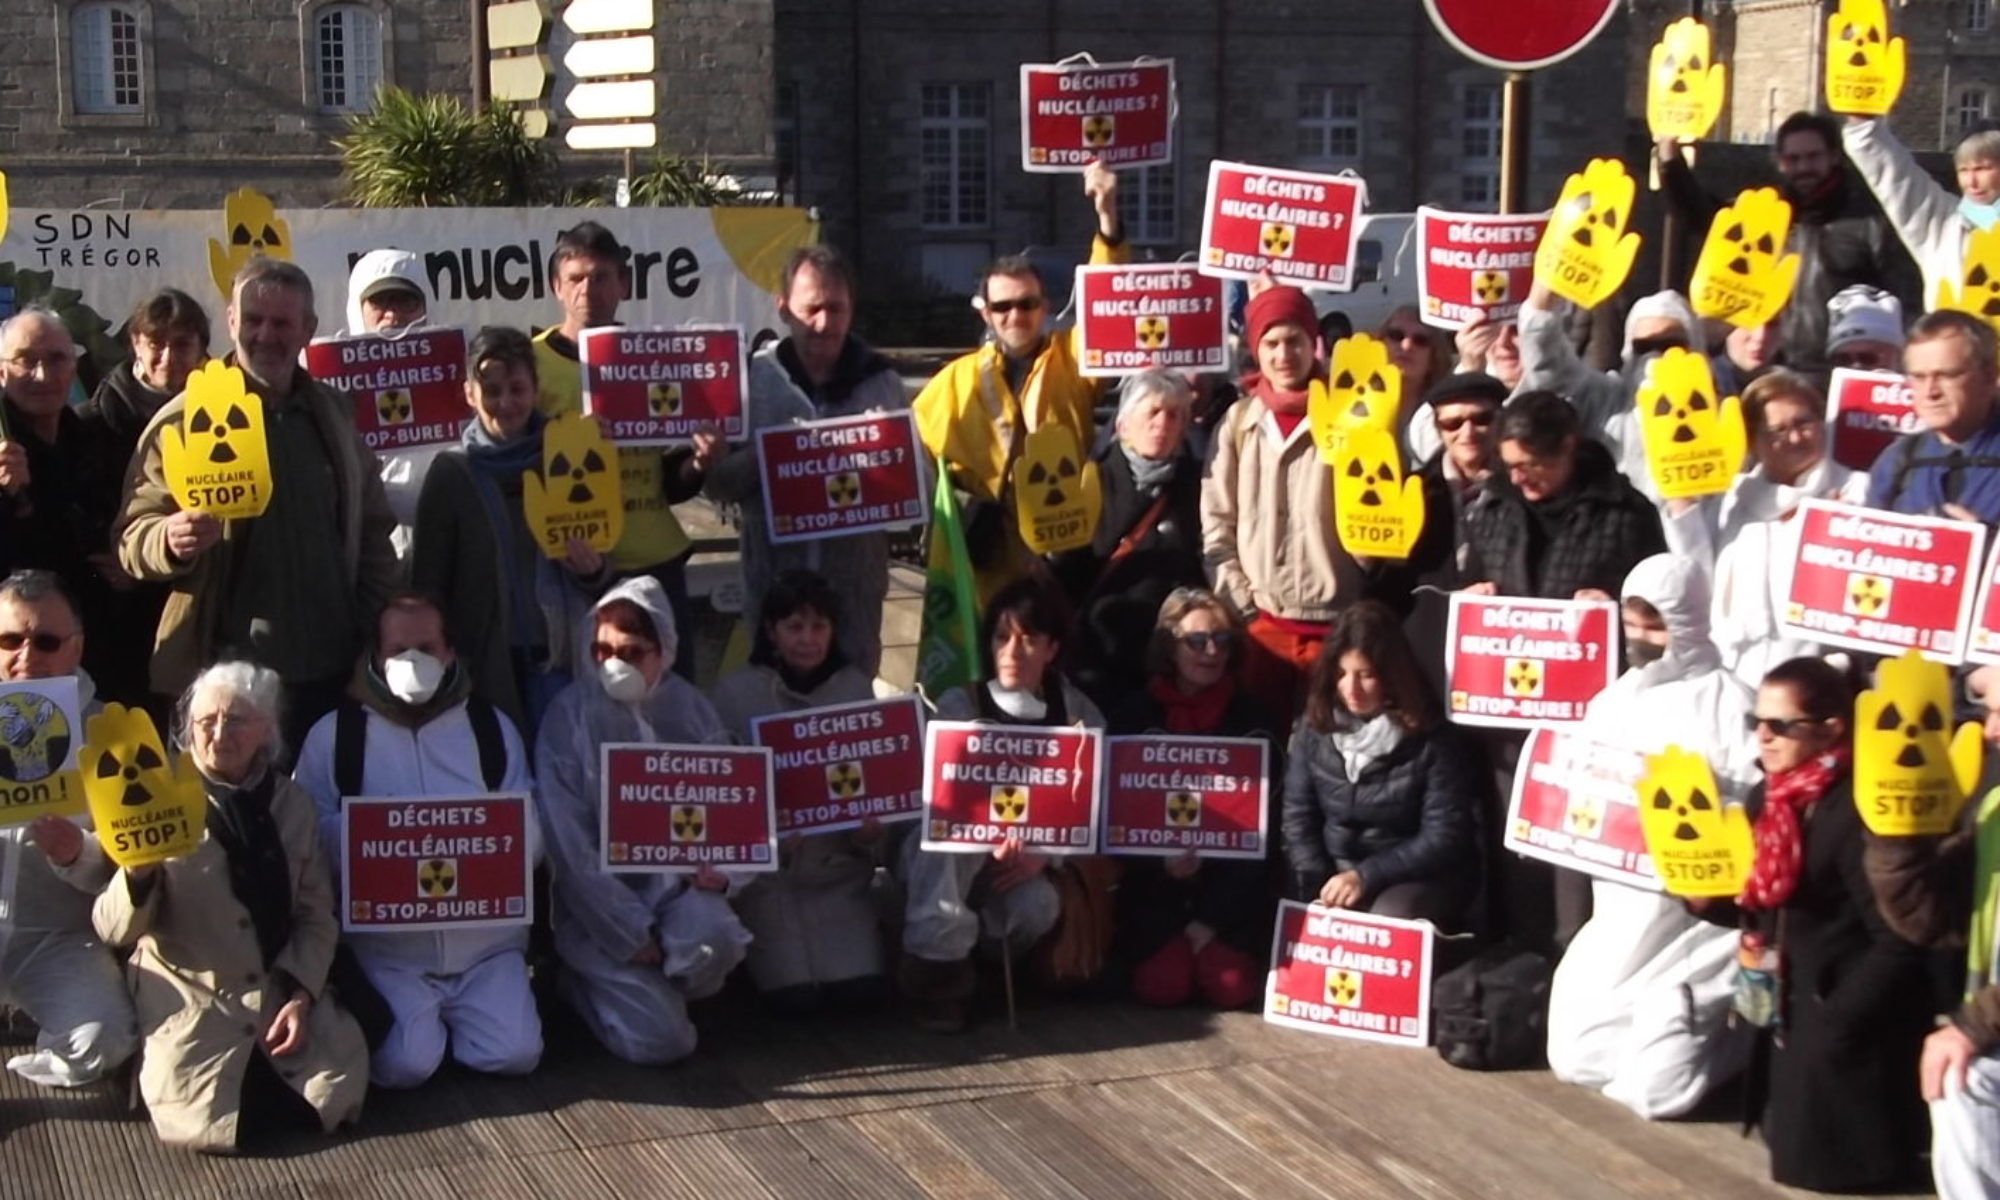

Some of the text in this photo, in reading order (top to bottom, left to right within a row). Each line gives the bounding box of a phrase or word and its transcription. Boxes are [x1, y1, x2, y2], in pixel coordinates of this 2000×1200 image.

[1059, 72, 1139, 91] DÉCHETS
[1038, 94, 1158, 115] NUCLÉAIRES ?
[1049, 146, 1139, 163] STOP-BURE
[1243, 175, 1326, 202] DÉCHETS
[1220, 199, 1344, 230] NUCLÉAIRES ?
[33, 213, 131, 245] SDN
[1448, 221, 1536, 243] DÉCHETS
[36, 244, 161, 268] TRÉGOR
[1224, 253, 1316, 278] STOP-BURE
[1430, 247, 1534, 269] NUCLÉAIRE
[425, 240, 700, 301] nuclire
[1112, 271, 1192, 291] DÉCHETS
[1092, 295, 1213, 317] NUCLÉAIRES ?
[342, 337, 431, 365] DÉCHETS
[620, 334, 706, 354] DÉCHETS
[1104, 349, 1196, 366] STOP-BURE
[600, 360, 730, 381] NUCLÉAIRES ?
[360, 424, 444, 447] OP-BURE
[796, 425, 881, 450] DÉCHETS
[777, 448, 904, 479] NUCLÉAIRES ?
[1662, 462, 1716, 484] STOP
[186, 470, 255, 486] NUCLÉAIRE
[188, 485, 245, 507] STOP
[794, 504, 891, 530] STOP-BURE
[547, 522, 600, 545] STOP
[1034, 520, 1080, 542] STOP
[1346, 524, 1395, 542] STOP
[1482, 605, 1576, 631] DÉCHETS
[1461, 634, 1599, 661] NUCLÉAIRES ?
[1467, 695, 1573, 718] STOP-BURE
[794, 710, 883, 739] DÉCHETS
[775, 735, 909, 770] NUCLÉAIRES ?
[967, 731, 1060, 757] DÉCHETS
[1143, 743, 1229, 764] DÉCHETS
[645, 752, 733, 775] DÉCHETS
[942, 761, 1068, 786] NUCLÉAIRES
[620, 781, 757, 804] NUCLÉAIRES ?
[1120, 771, 1251, 793] NUCLÉAIRES ?
[111, 806, 184, 829] NUCLÉAIRE
[388, 804, 487, 827] DÉCHETS
[794, 796, 896, 824] STOP-BURE
[1876, 795, 1938, 817] STOP
[115, 823, 177, 852] STOP
[951, 824, 1055, 843] STOP-BURE
[1128, 829, 1228, 846] STOP-BURE
[362, 834, 513, 858] NUCLÉAIRES ?
[632, 845, 736, 862] STOP-BURE
[1664, 862, 1722, 880] STOP
[376, 900, 489, 919] STOP-BURE
[1307, 915, 1391, 947] DÉCHETS
[1287, 942, 1412, 979] NUCLÉAIRES ?
[1289, 1000, 1387, 1031] STOP-BURE
